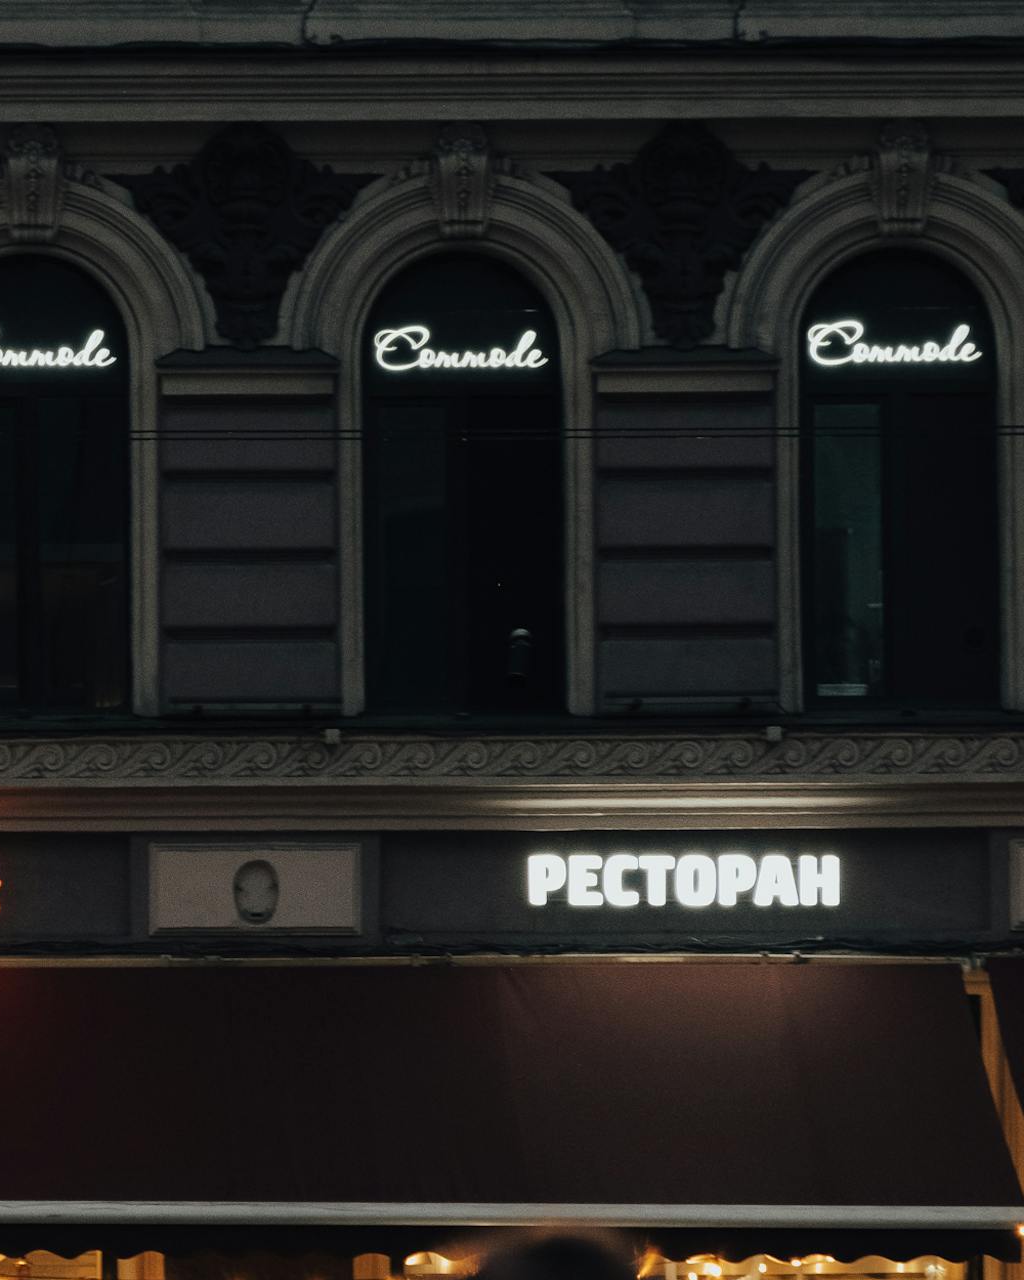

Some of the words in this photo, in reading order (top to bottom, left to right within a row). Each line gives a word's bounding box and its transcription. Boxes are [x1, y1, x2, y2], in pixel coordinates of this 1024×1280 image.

[374, 325, 549, 371] Commode
[807, 319, 982, 366] Commode
[526, 852, 841, 908] РЕСТОРАН
